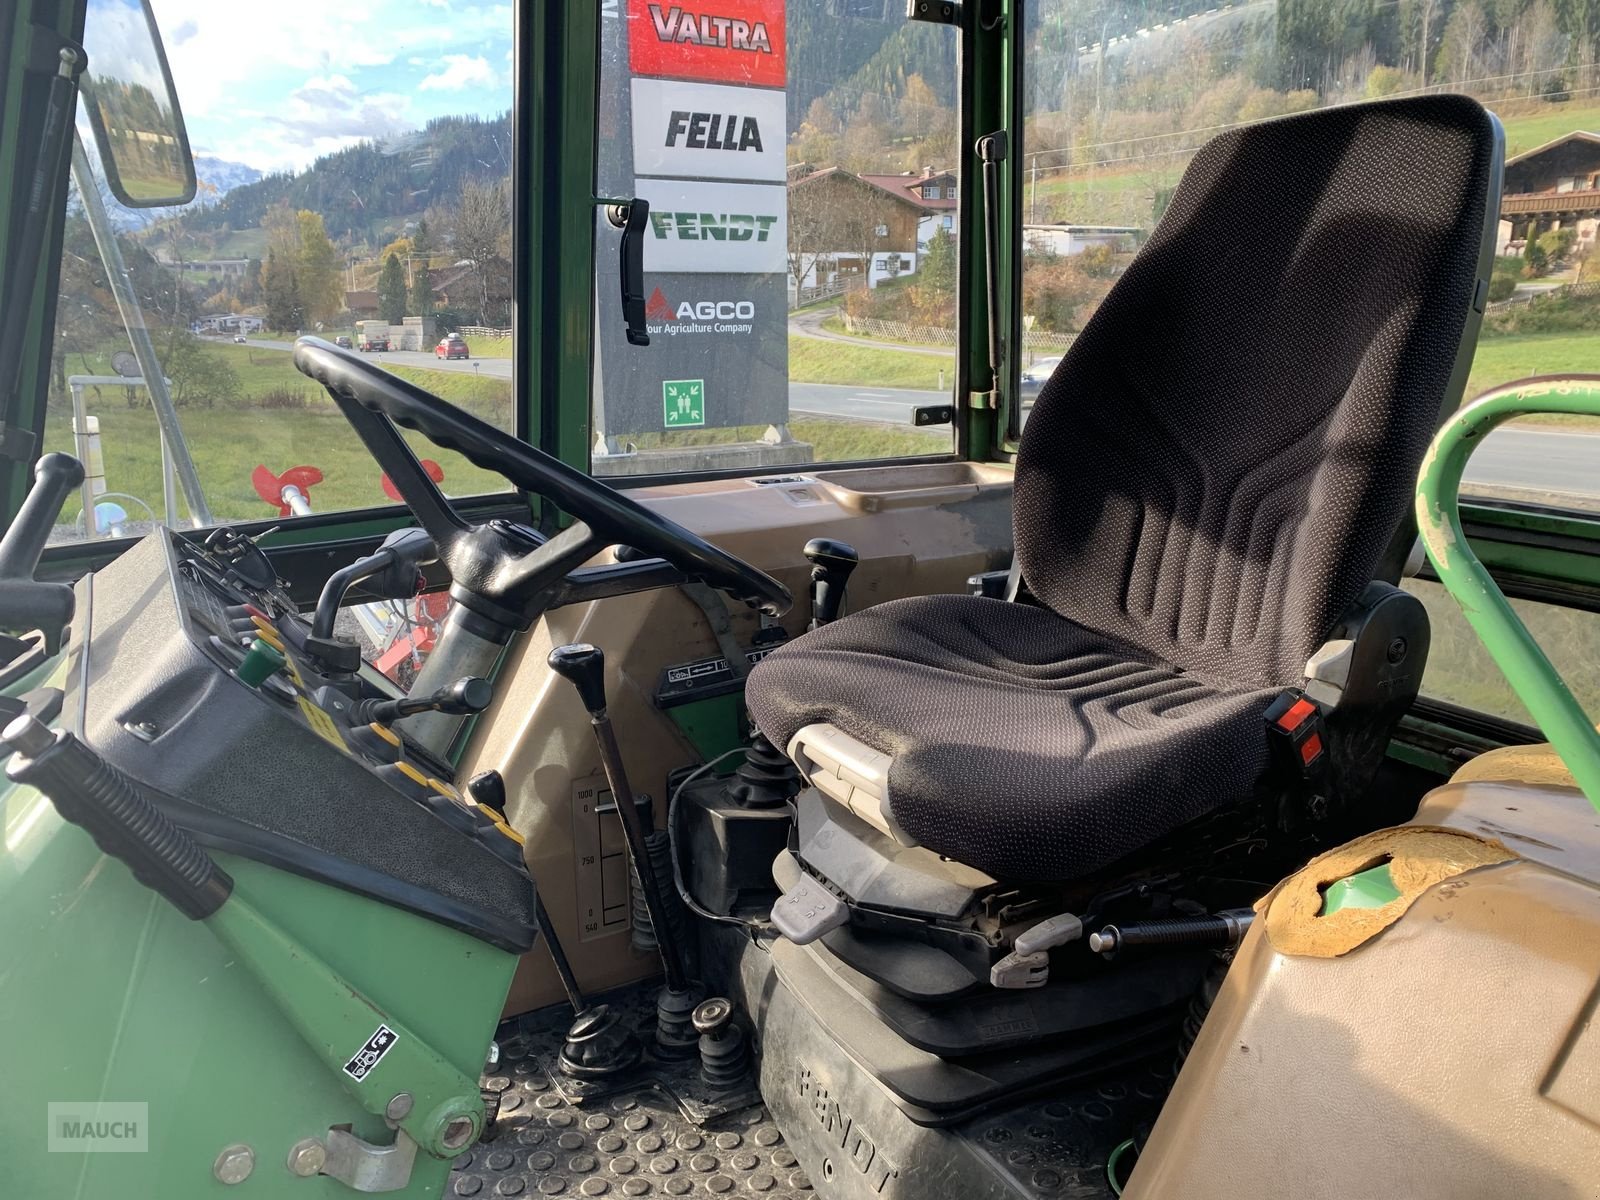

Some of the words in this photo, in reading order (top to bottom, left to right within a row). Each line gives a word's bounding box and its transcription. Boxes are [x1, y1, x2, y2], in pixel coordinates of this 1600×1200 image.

[648, 4, 772, 54] VALTRA
[665, 111, 763, 152] FELLA
[649, 211, 777, 242] FENDT
[676, 301, 755, 320] AGCO
[646, 323, 662, 334] our
[664, 323, 712, 336] Agriculture
[714, 322, 753, 334] Company
[578, 789, 593, 800] 1000
[583, 804, 588, 813] 0
[582, 856, 595, 866] 750
[585, 922, 598, 933] 540
[796, 1056, 898, 1193] FENDT
